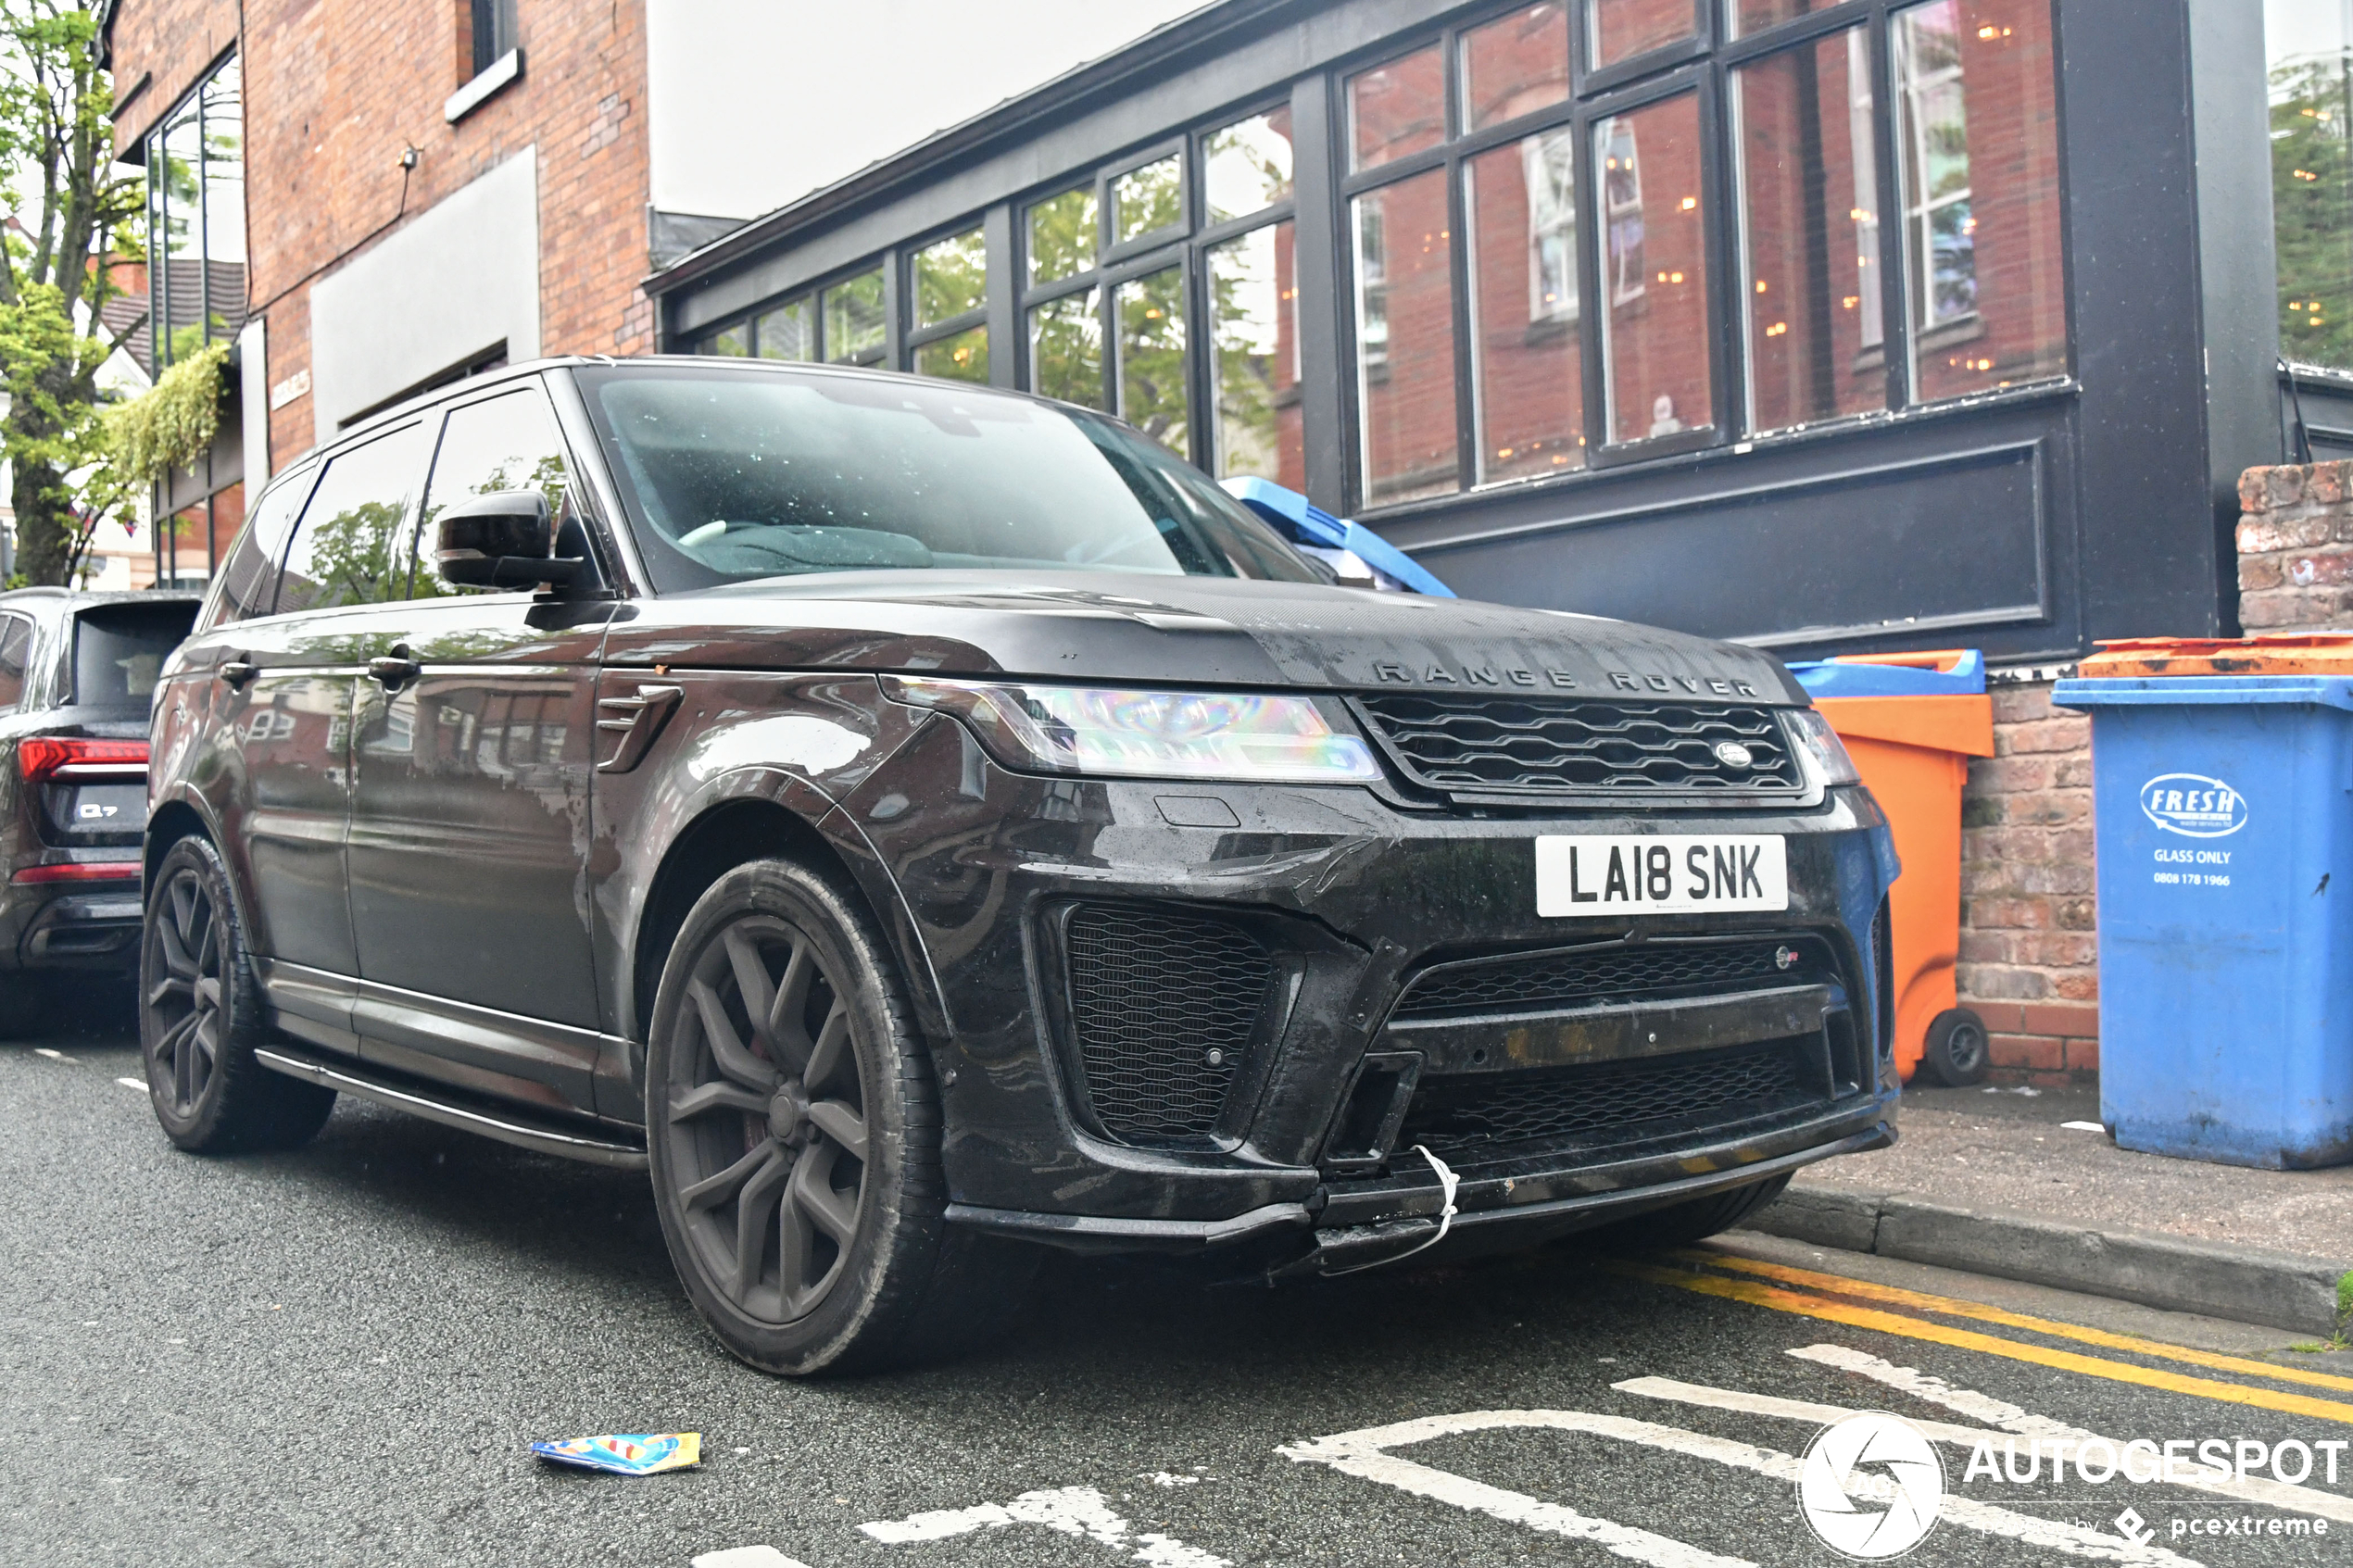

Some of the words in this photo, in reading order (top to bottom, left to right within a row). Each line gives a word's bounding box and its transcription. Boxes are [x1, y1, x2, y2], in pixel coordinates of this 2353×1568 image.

[1373, 661, 1576, 687] RANGE
[1608, 671, 1757, 696] ROVER
[81, 803, 118, 818] Q7
[2150, 789, 2235, 813] FRESH
[2154, 849, 2195, 863] GLASS
[2196, 850, 2232, 864] ONLY
[1569, 845, 1672, 903] LA18
[1686, 845, 1764, 900] SNK
[2154, 872, 2180, 884] 0808
[2182, 873, 2201, 885] 178
[2204, 874, 2231, 886] 1966
